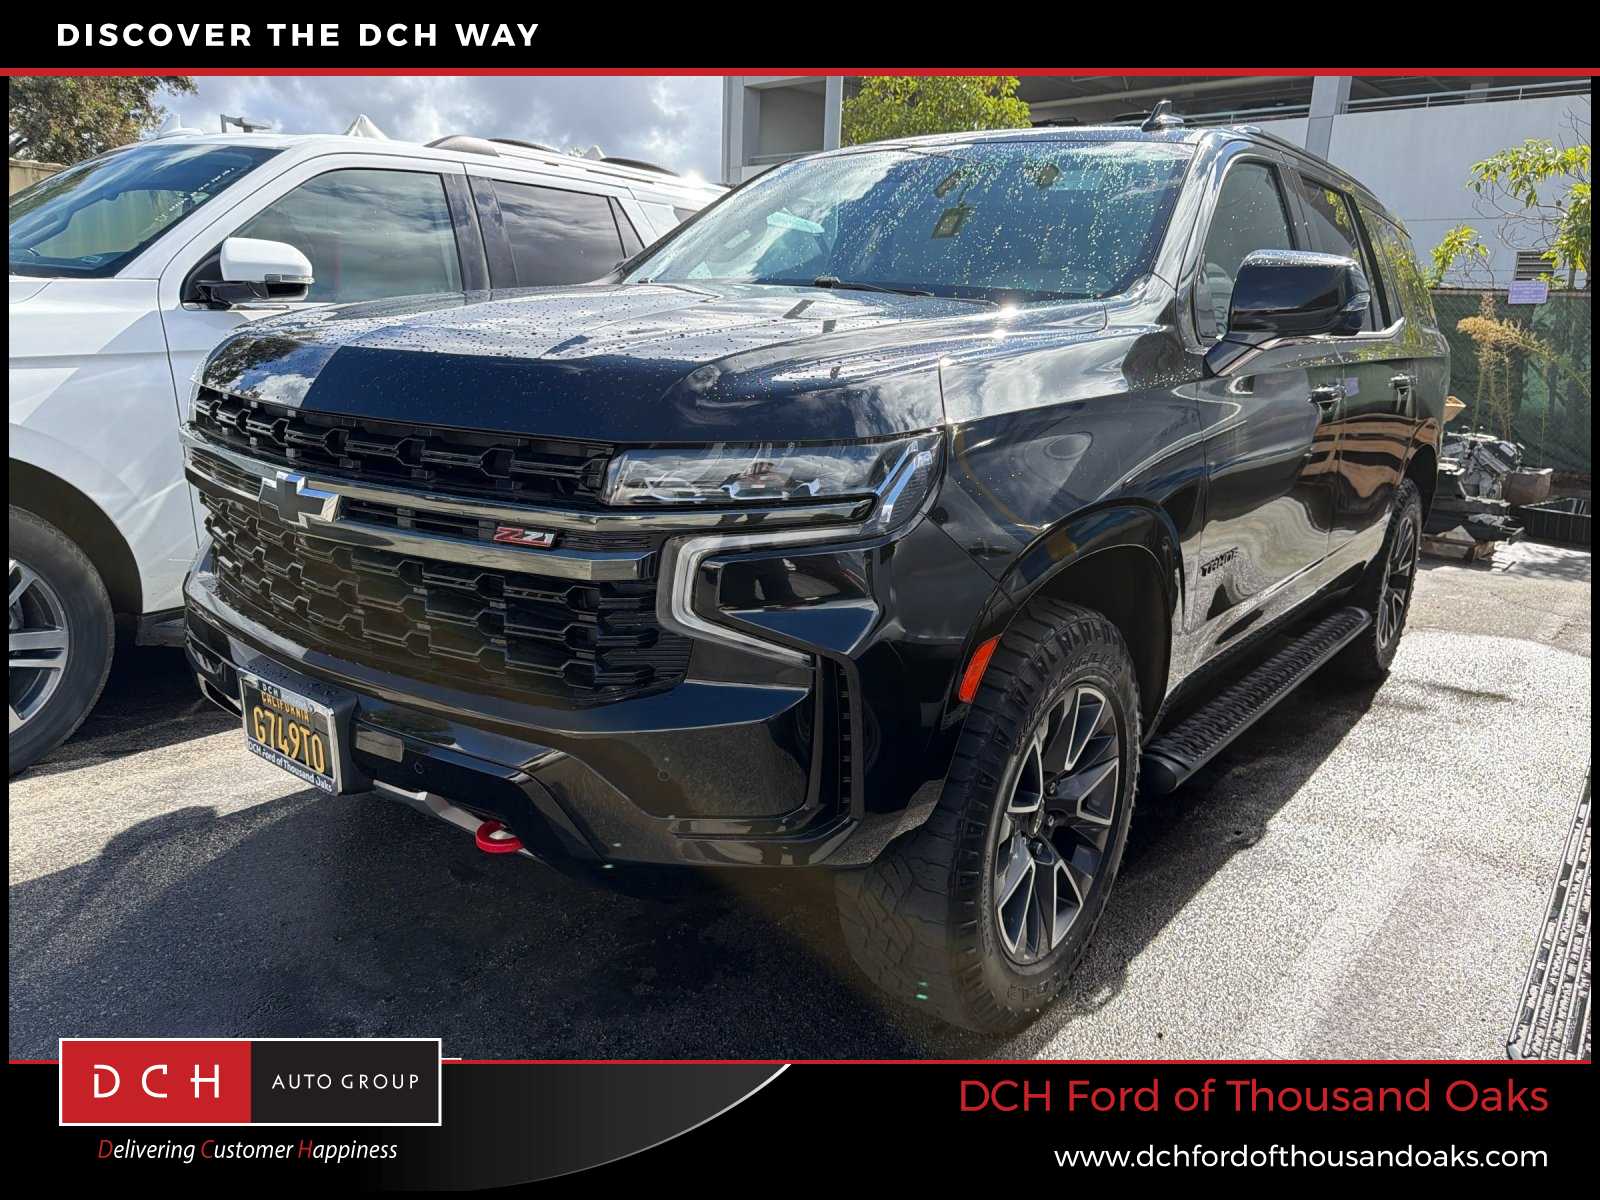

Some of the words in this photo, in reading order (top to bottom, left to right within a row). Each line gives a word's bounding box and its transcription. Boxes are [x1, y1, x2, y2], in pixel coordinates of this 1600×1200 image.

[261, 691, 310, 722] CALIFORNIA
[248, 741, 261, 755] DCH
[262, 748, 276, 763] Ford
[276, 756, 284, 768] of
[283, 759, 315, 784] Thousand
[315, 776, 333, 793] Oaks
